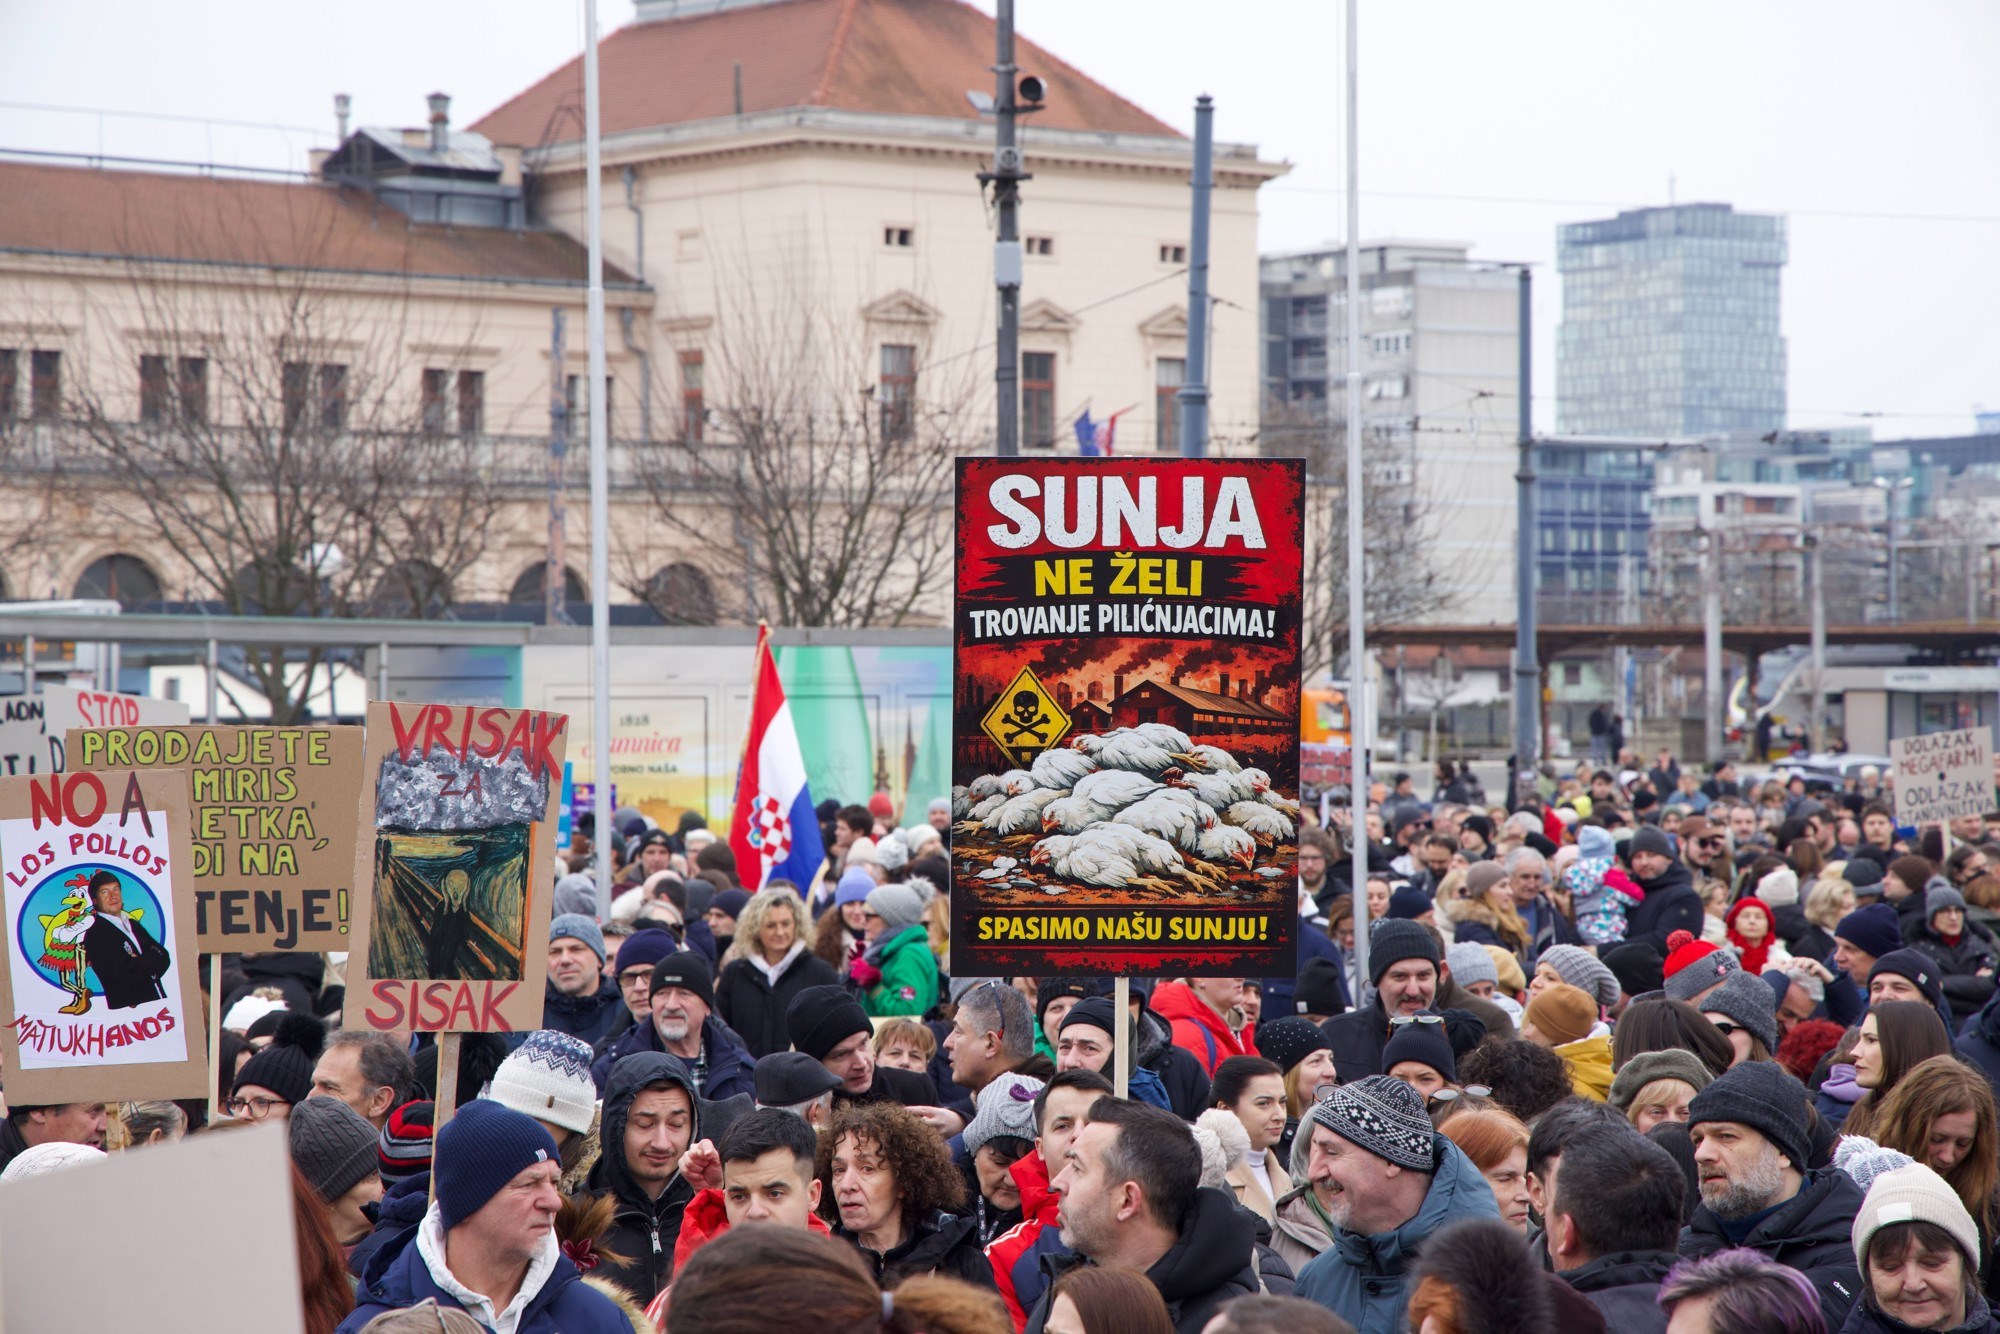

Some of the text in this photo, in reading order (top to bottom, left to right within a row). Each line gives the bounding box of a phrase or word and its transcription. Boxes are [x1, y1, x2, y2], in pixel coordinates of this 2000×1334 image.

[987, 474, 1267, 549] SUNJA
[1034, 552, 1203, 597] NE ŽELI
[969, 598, 1276, 639] TROVANJE PILIĆNJACIMA!
[77, 691, 139, 727] STOP
[82, 730, 330, 765] PRODAJETE
[389, 702, 568, 784] VRISAK
[1900, 746, 1983, 776] MEGAFARMI
[1904, 731, 1973, 755] DOLAZAK
[193, 767, 298, 802] MIRIS
[437, 770, 482, 804] ZA
[1905, 780, 1987, 806] ODLAZAK
[30, 771, 154, 839] NO A
[6, 833, 167, 888] LOS POLLOS
[240, 843, 299, 876] NA
[978, 911, 1268, 941] SPASIMO NAŠU SUNJU!
[365, 980, 519, 1032] SISAK
[3, 1007, 175, 1057] MATIUKHANOS
